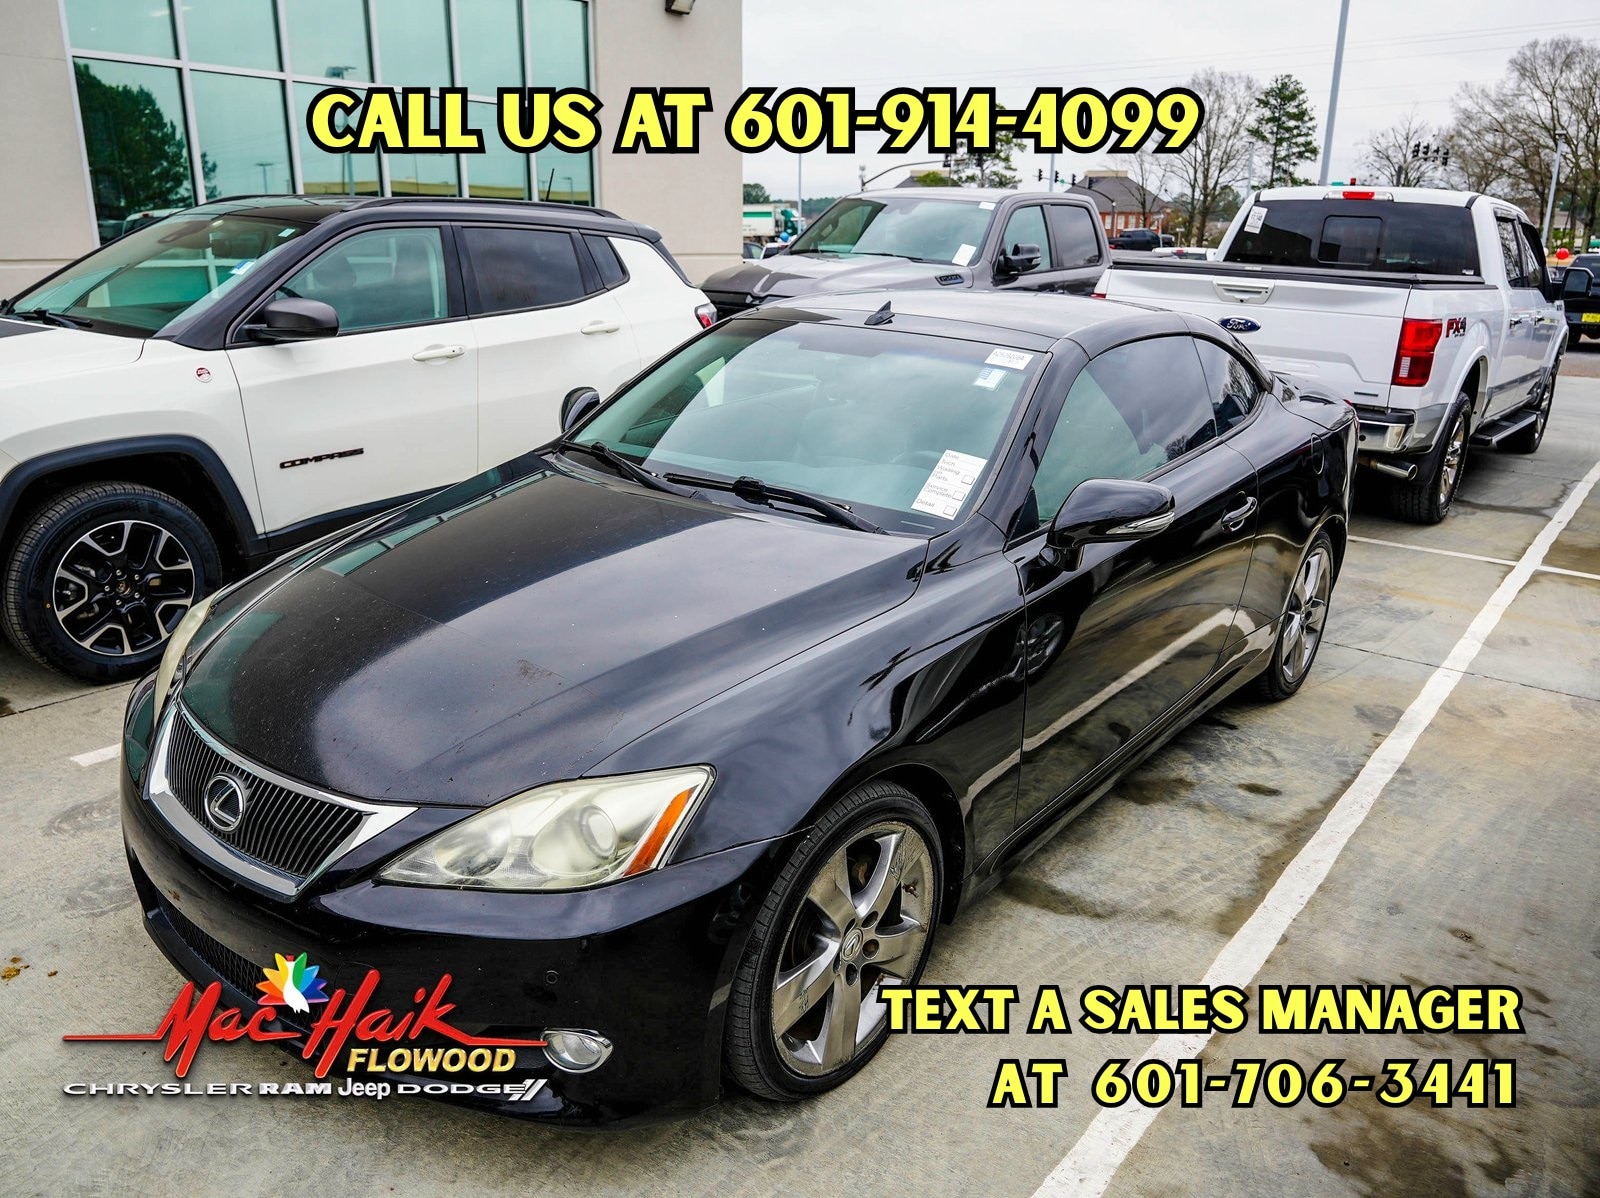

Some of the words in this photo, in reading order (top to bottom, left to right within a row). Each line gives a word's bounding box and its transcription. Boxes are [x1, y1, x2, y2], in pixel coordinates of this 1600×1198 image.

[1445, 317, 1467, 338] FX4
[279, 447, 364, 469] COMPASS
[927, 482, 949, 492] Service
[915, 498, 936, 508] Detail
